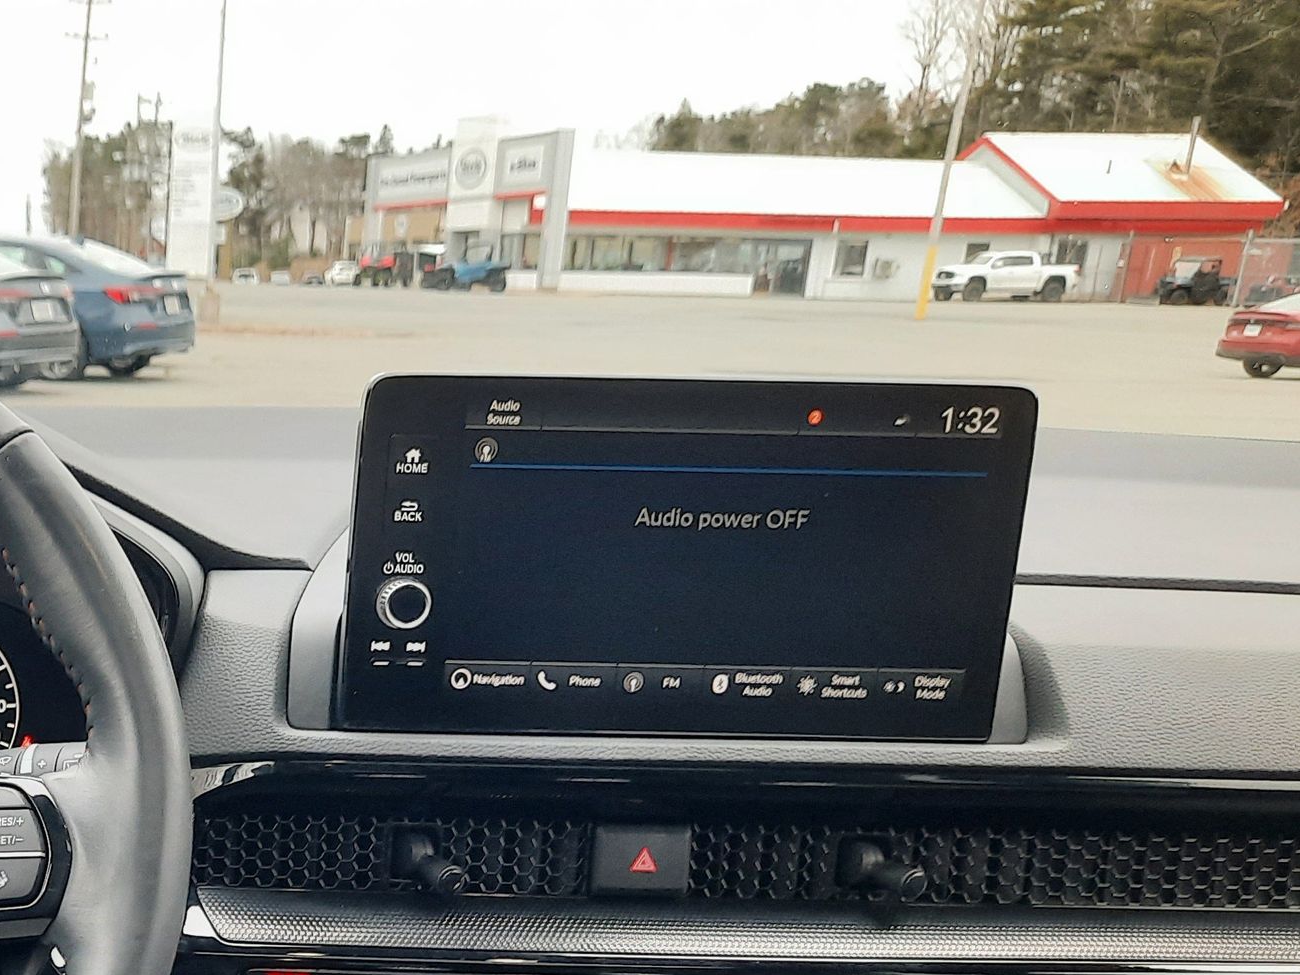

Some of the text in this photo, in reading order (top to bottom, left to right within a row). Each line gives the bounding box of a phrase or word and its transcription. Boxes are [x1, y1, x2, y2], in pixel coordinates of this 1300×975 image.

[489, 399, 521, 412] Audio
[486, 414, 521, 426] Source
[941, 406, 1001, 434] 1:32
[395, 462, 429, 474] HOME
[393, 511, 422, 522] BACK
[634, 506, 811, 533] Audio power OFF
[395, 552, 415, 563] VOL
[393, 563, 425, 574] AUDIO
[472, 673, 525, 687] Navigation
[568, 675, 602, 687] Phone
[662, 676, 681, 688] FM
[734, 672, 784, 685] Bluetooth
[831, 674, 861, 686] Smart
[914, 675, 951, 689] Display
[742, 685, 773, 697] Audio
[821, 686, 868, 699] Shortcuts
[915, 688, 945, 700] Mode
